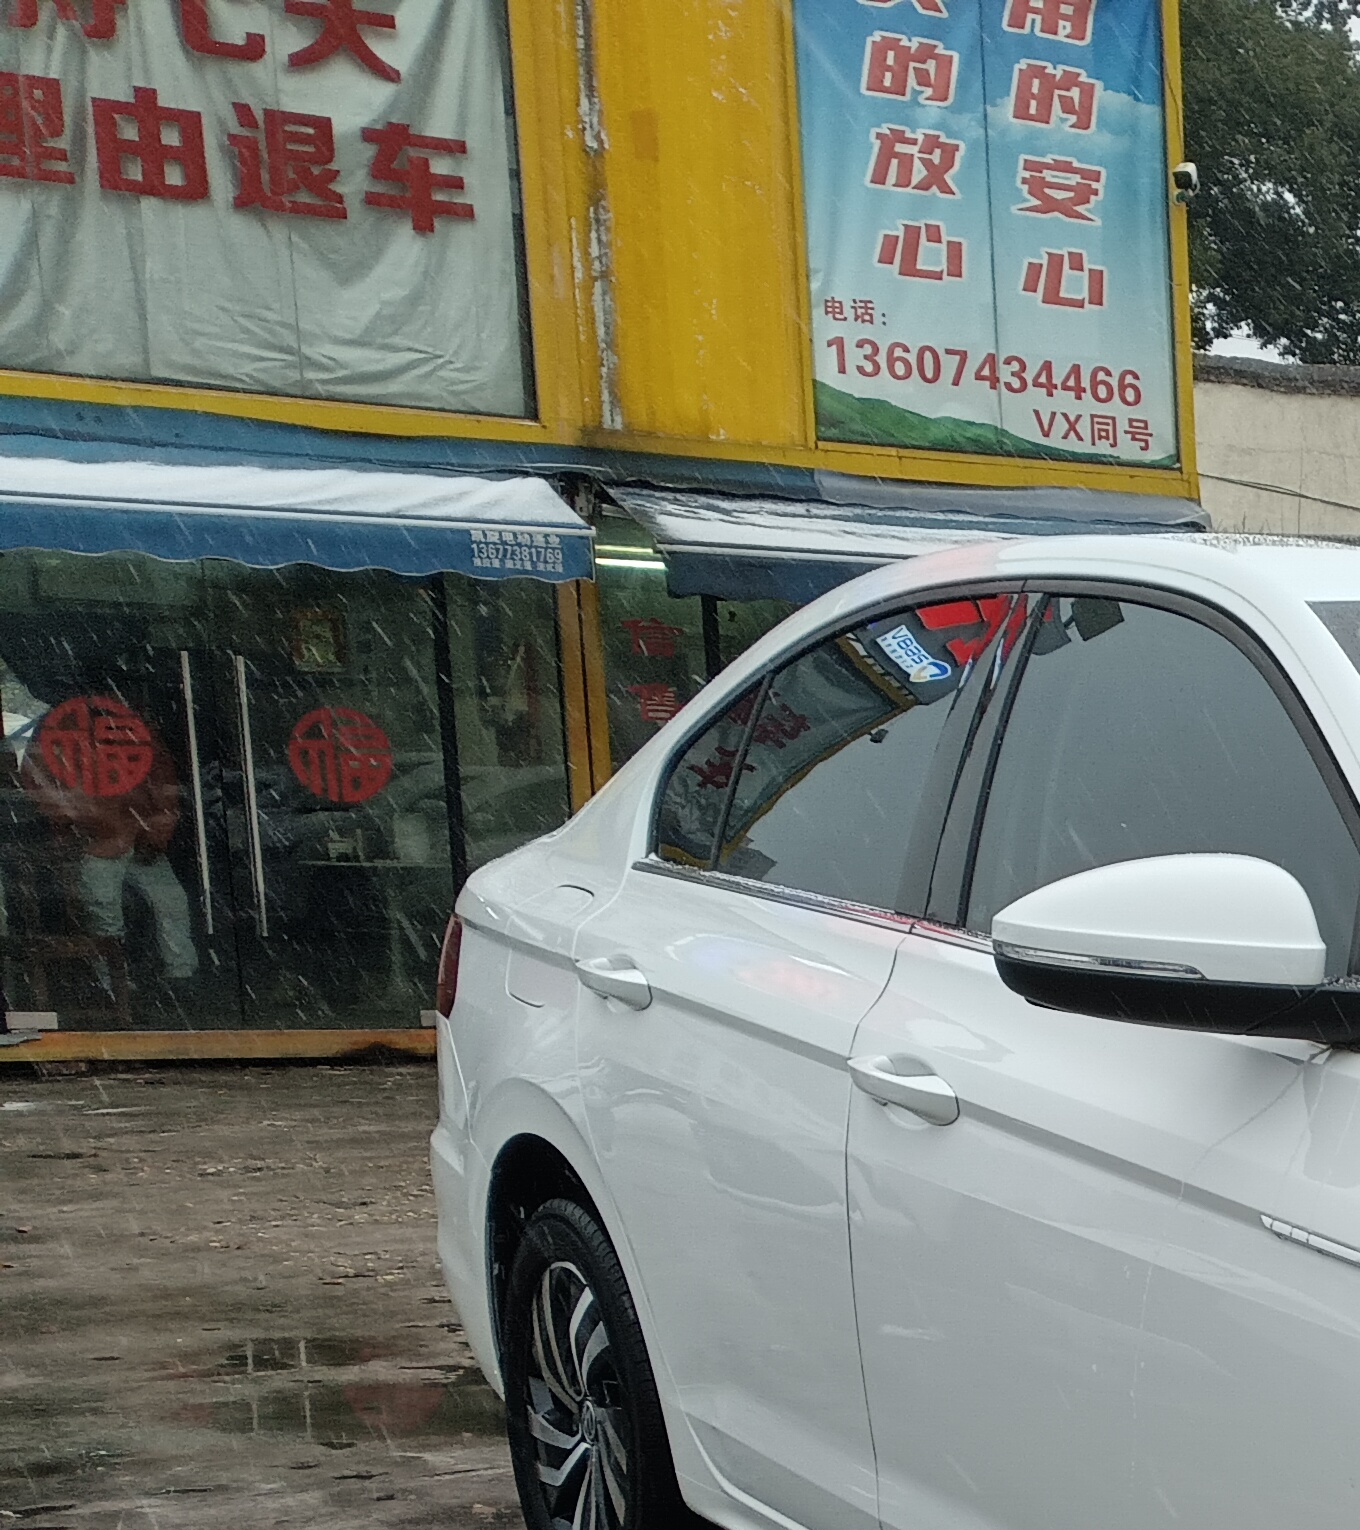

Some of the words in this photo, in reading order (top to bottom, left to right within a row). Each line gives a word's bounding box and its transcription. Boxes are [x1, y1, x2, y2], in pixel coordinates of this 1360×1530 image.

[857, 0, 966, 281] 的放心
[826, 335, 1142, 407] 13607434466
[1032, 408, 1154, 451] VX同号
[471, 543, 562, 563] 13677381769
[40, 696, 154, 797] 福
[289, 707, 393, 803] 福
